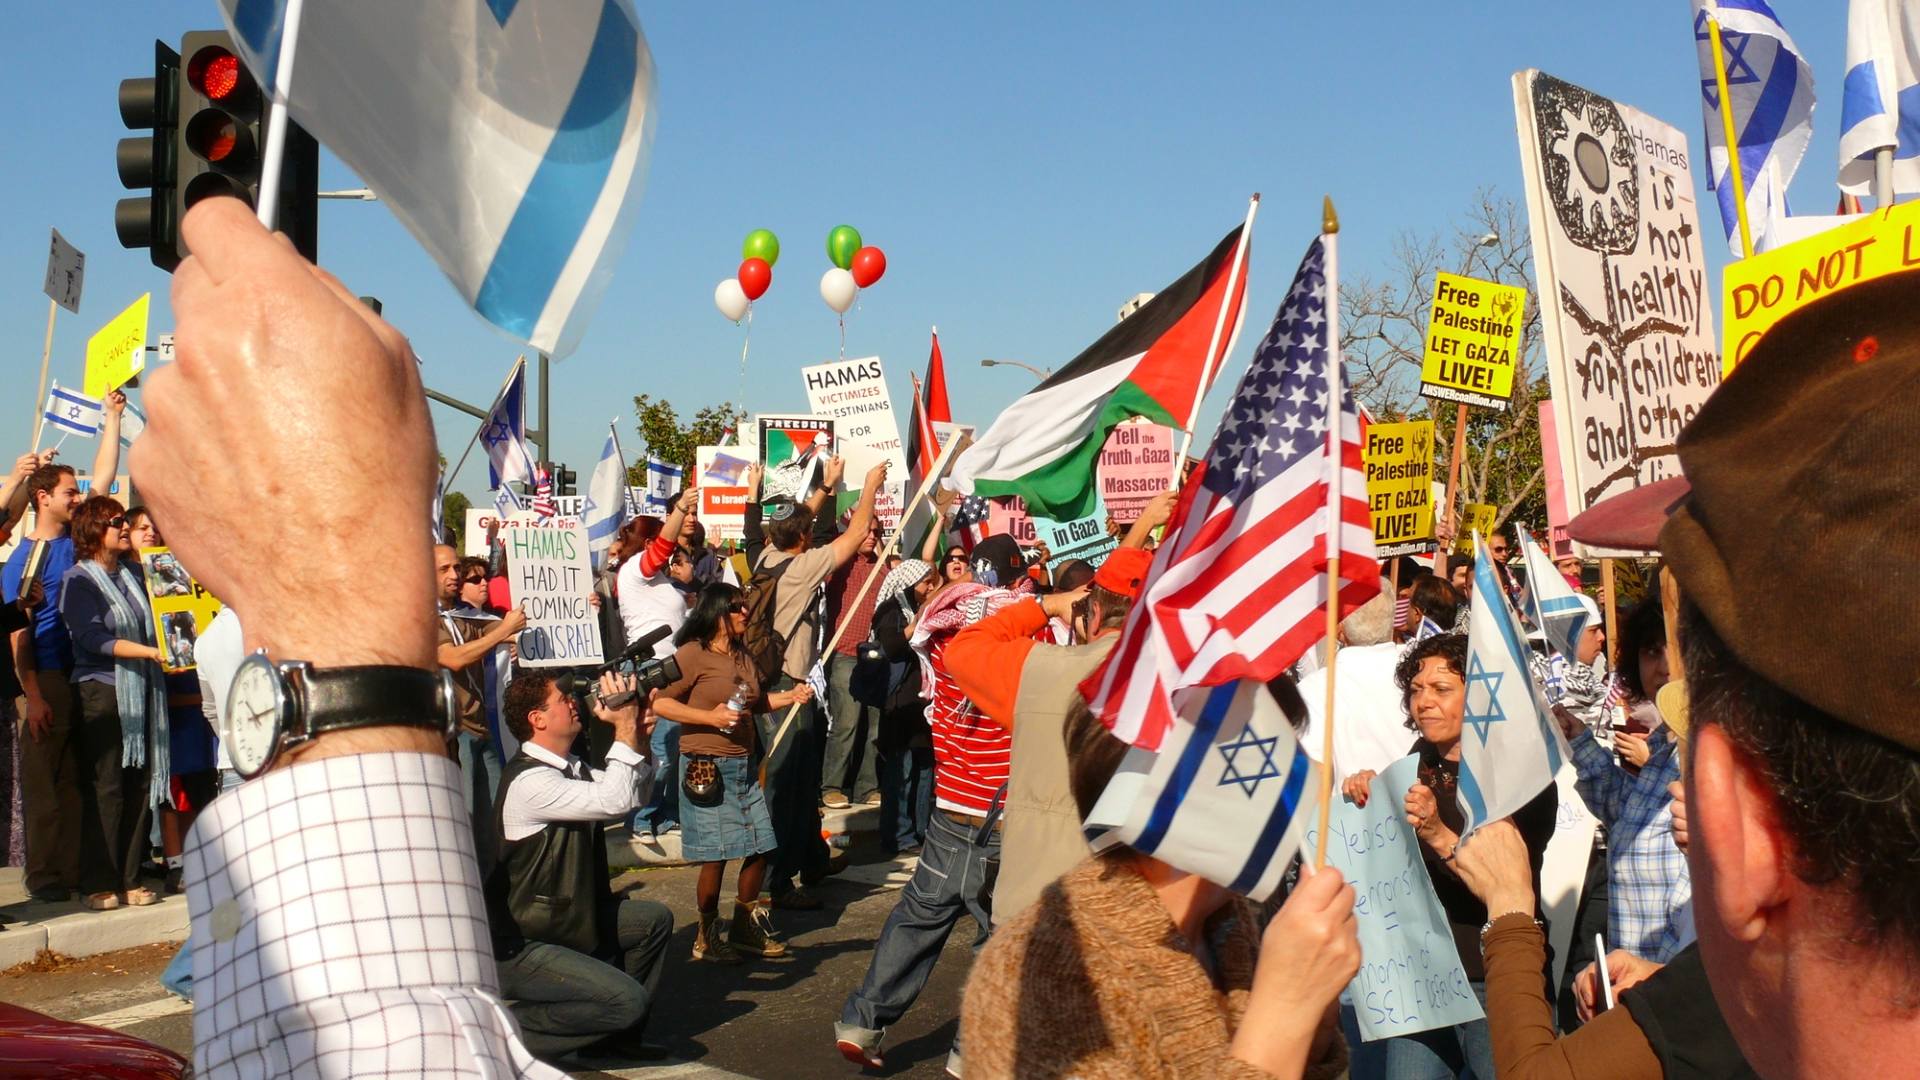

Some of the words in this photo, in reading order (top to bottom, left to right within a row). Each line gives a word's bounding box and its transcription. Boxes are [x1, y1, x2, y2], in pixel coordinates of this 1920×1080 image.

[1630, 125, 1688, 170] Hamas
[1650, 165, 1676, 211] is
[1647, 212, 1693, 263] not
[1732, 274, 1784, 320] DO
[1796, 236, 1877, 301] NOT
[1437, 281, 1480, 308] Free
[1613, 264, 1702, 336] healthy
[1433, 307, 1514, 338] Palestine
[1431, 335, 1461, 356] LET
[1465, 343, 1510, 366] GAZA
[807, 361, 882, 391] HAMAS
[1438, 360, 1494, 390] LIVE!
[1575, 341, 1619, 400] for
[1631, 336, 1717, 398] children
[819, 386, 881, 405] VICTIMIZES
[1421, 383, 1506, 411] ANSWERcoalition.org
[766, 420, 828, 430] FREEDOM
[849, 425, 872, 438] FOR
[1115, 427, 1140, 445] Tell
[1142, 435, 1155, 444] the
[1585, 402, 1628, 470] and
[1101, 449, 1132, 466] Truth
[1142, 447, 1170, 464] Gaza
[1368, 433, 1404, 456] Free
[1105, 477, 1169, 493] Massacre
[1367, 460, 1428, 482] Palestine
[1368, 493, 1391, 512] LET
[1396, 489, 1427, 509] GAZA
[1009, 517, 1036, 541] Lie
[1052, 527, 1070, 548] in
[1068, 519, 1099, 541] Gaza
[1375, 512, 1417, 540] LIVE!
[513, 528, 577, 560] HAMAS
[522, 565, 558, 592] HAD
[562, 566, 580, 592] IT
[519, 596, 592, 620] COMING!!
[520, 627, 546, 661] GO
[549, 623, 602, 659] ISRAEL
